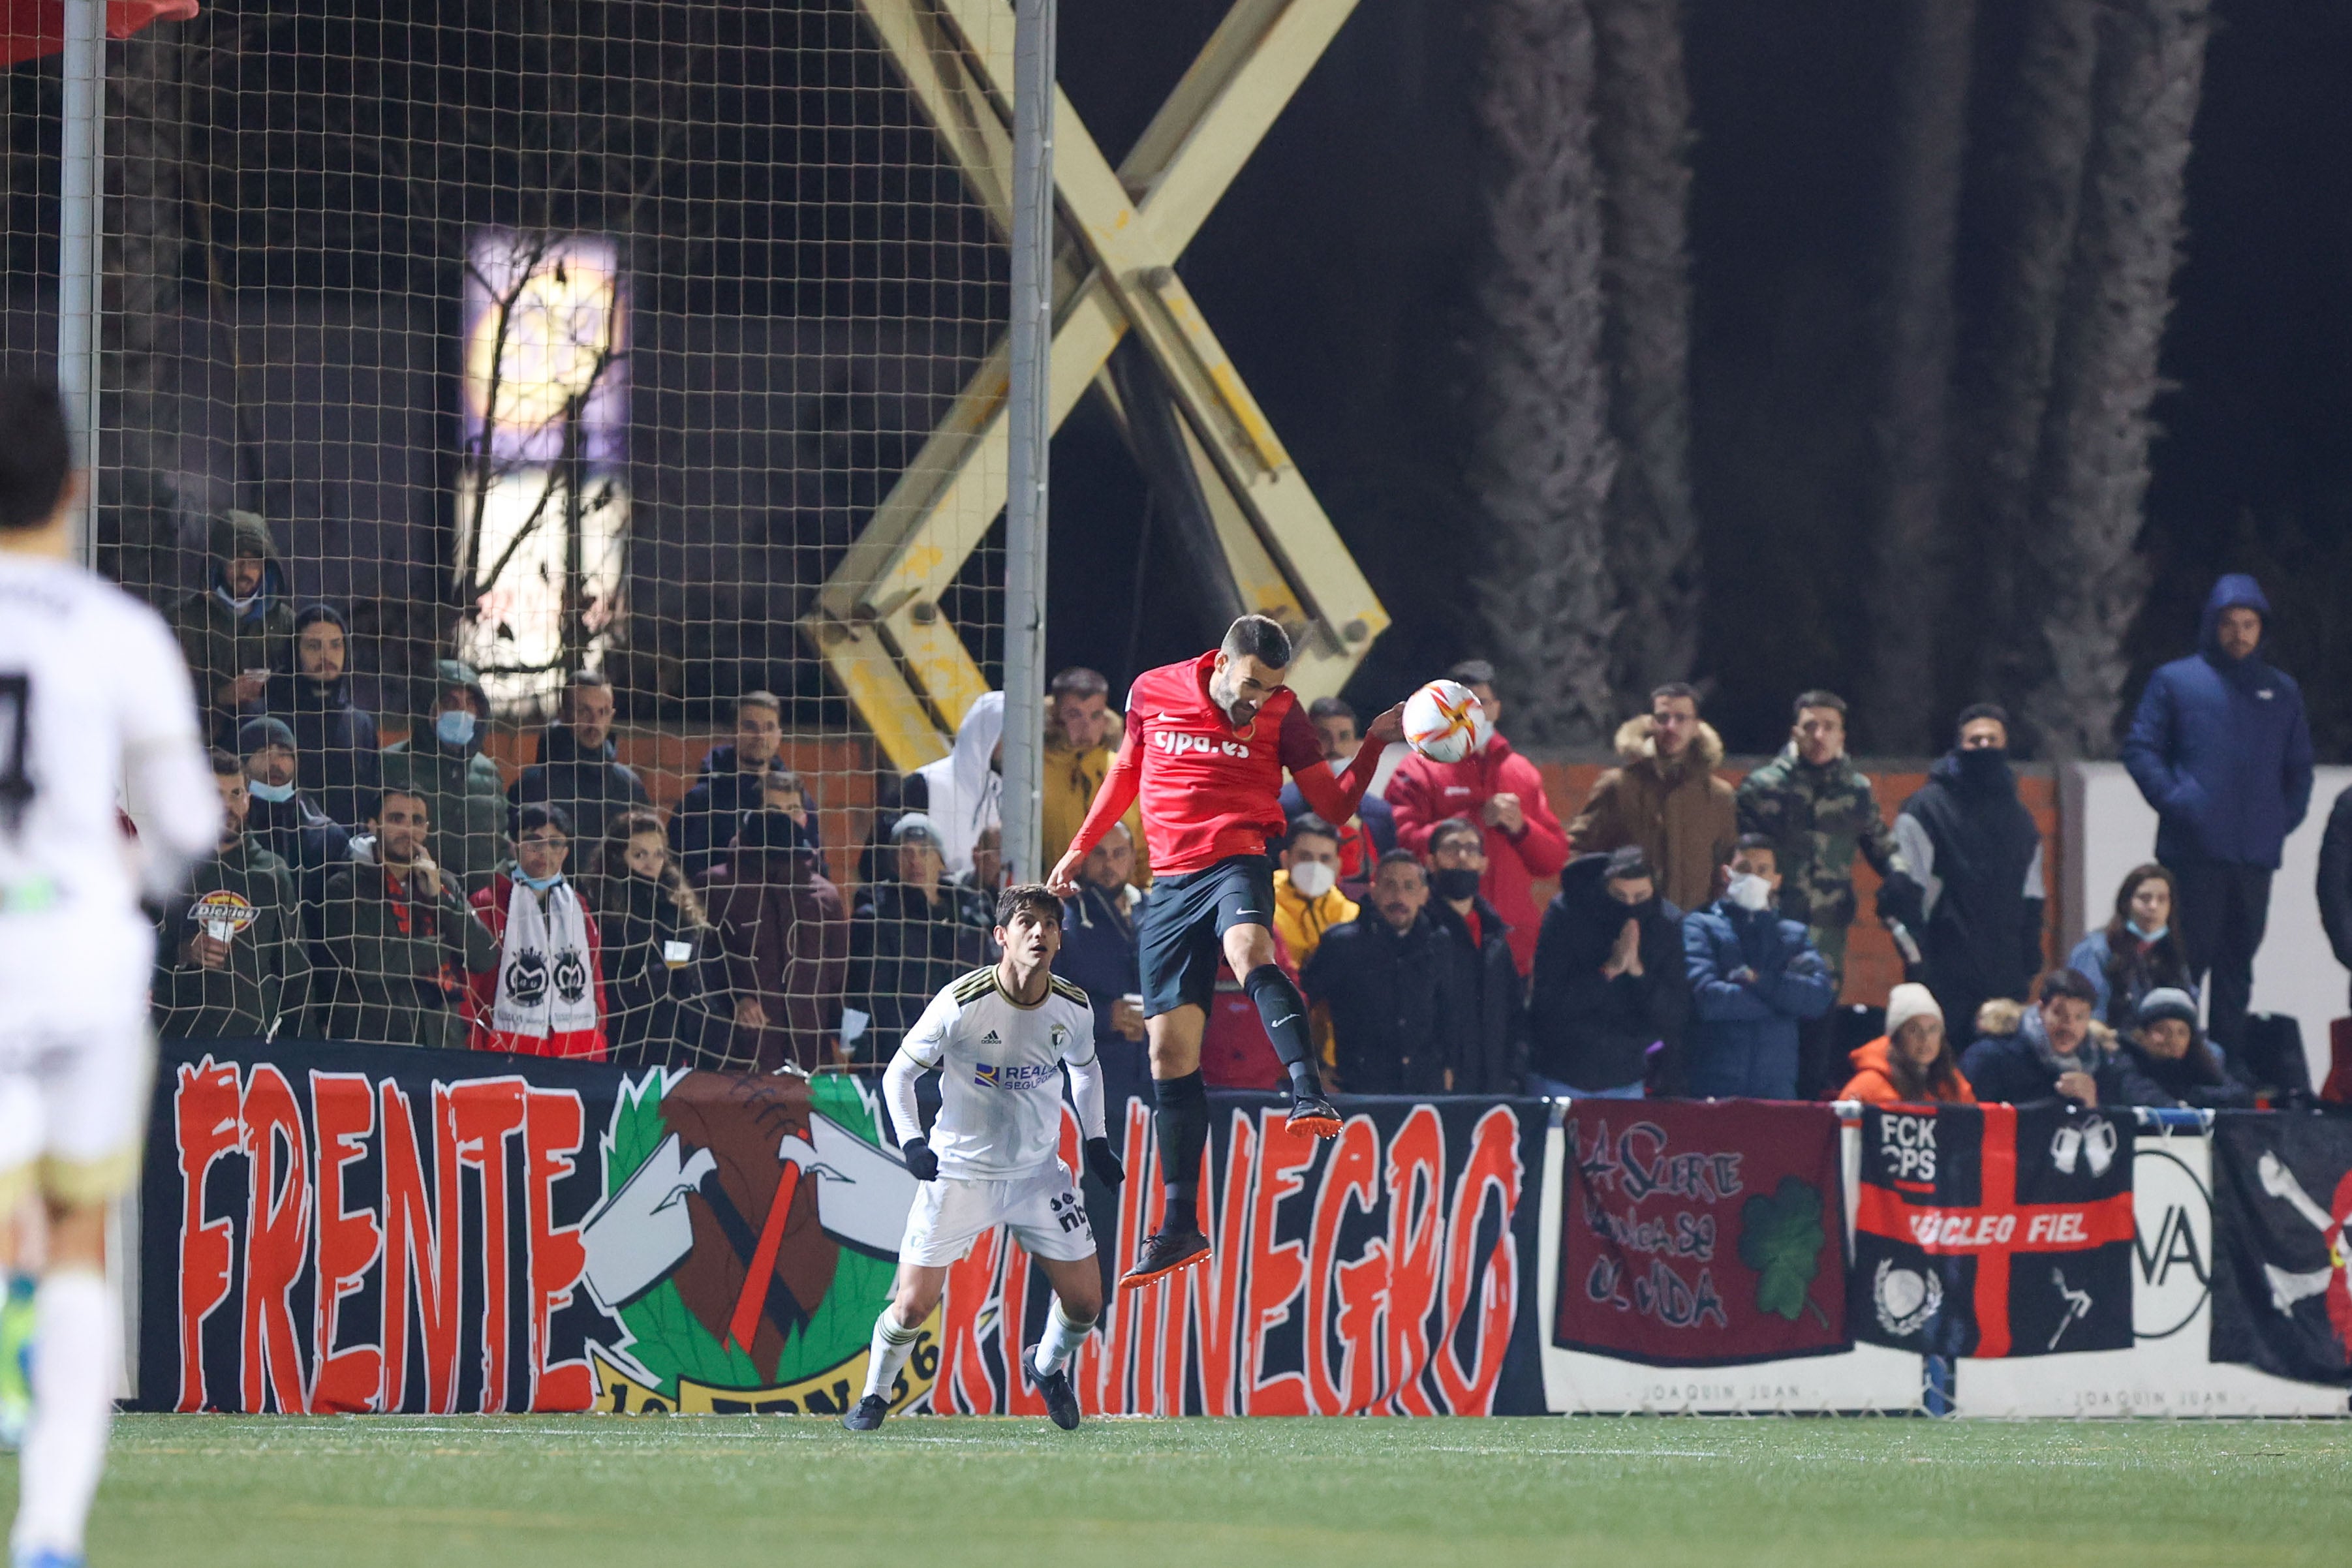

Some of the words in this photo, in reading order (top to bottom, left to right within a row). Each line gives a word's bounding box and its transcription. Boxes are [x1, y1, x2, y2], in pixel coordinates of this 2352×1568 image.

[1880, 1113, 1938, 1148] FCK
[174, 1053, 594, 1414] FRENTE
[2027, 1212, 2088, 1244] FIEL
[611, 1383, 669, 1413] 1
[1750, 1383, 1800, 1400] JUAN
